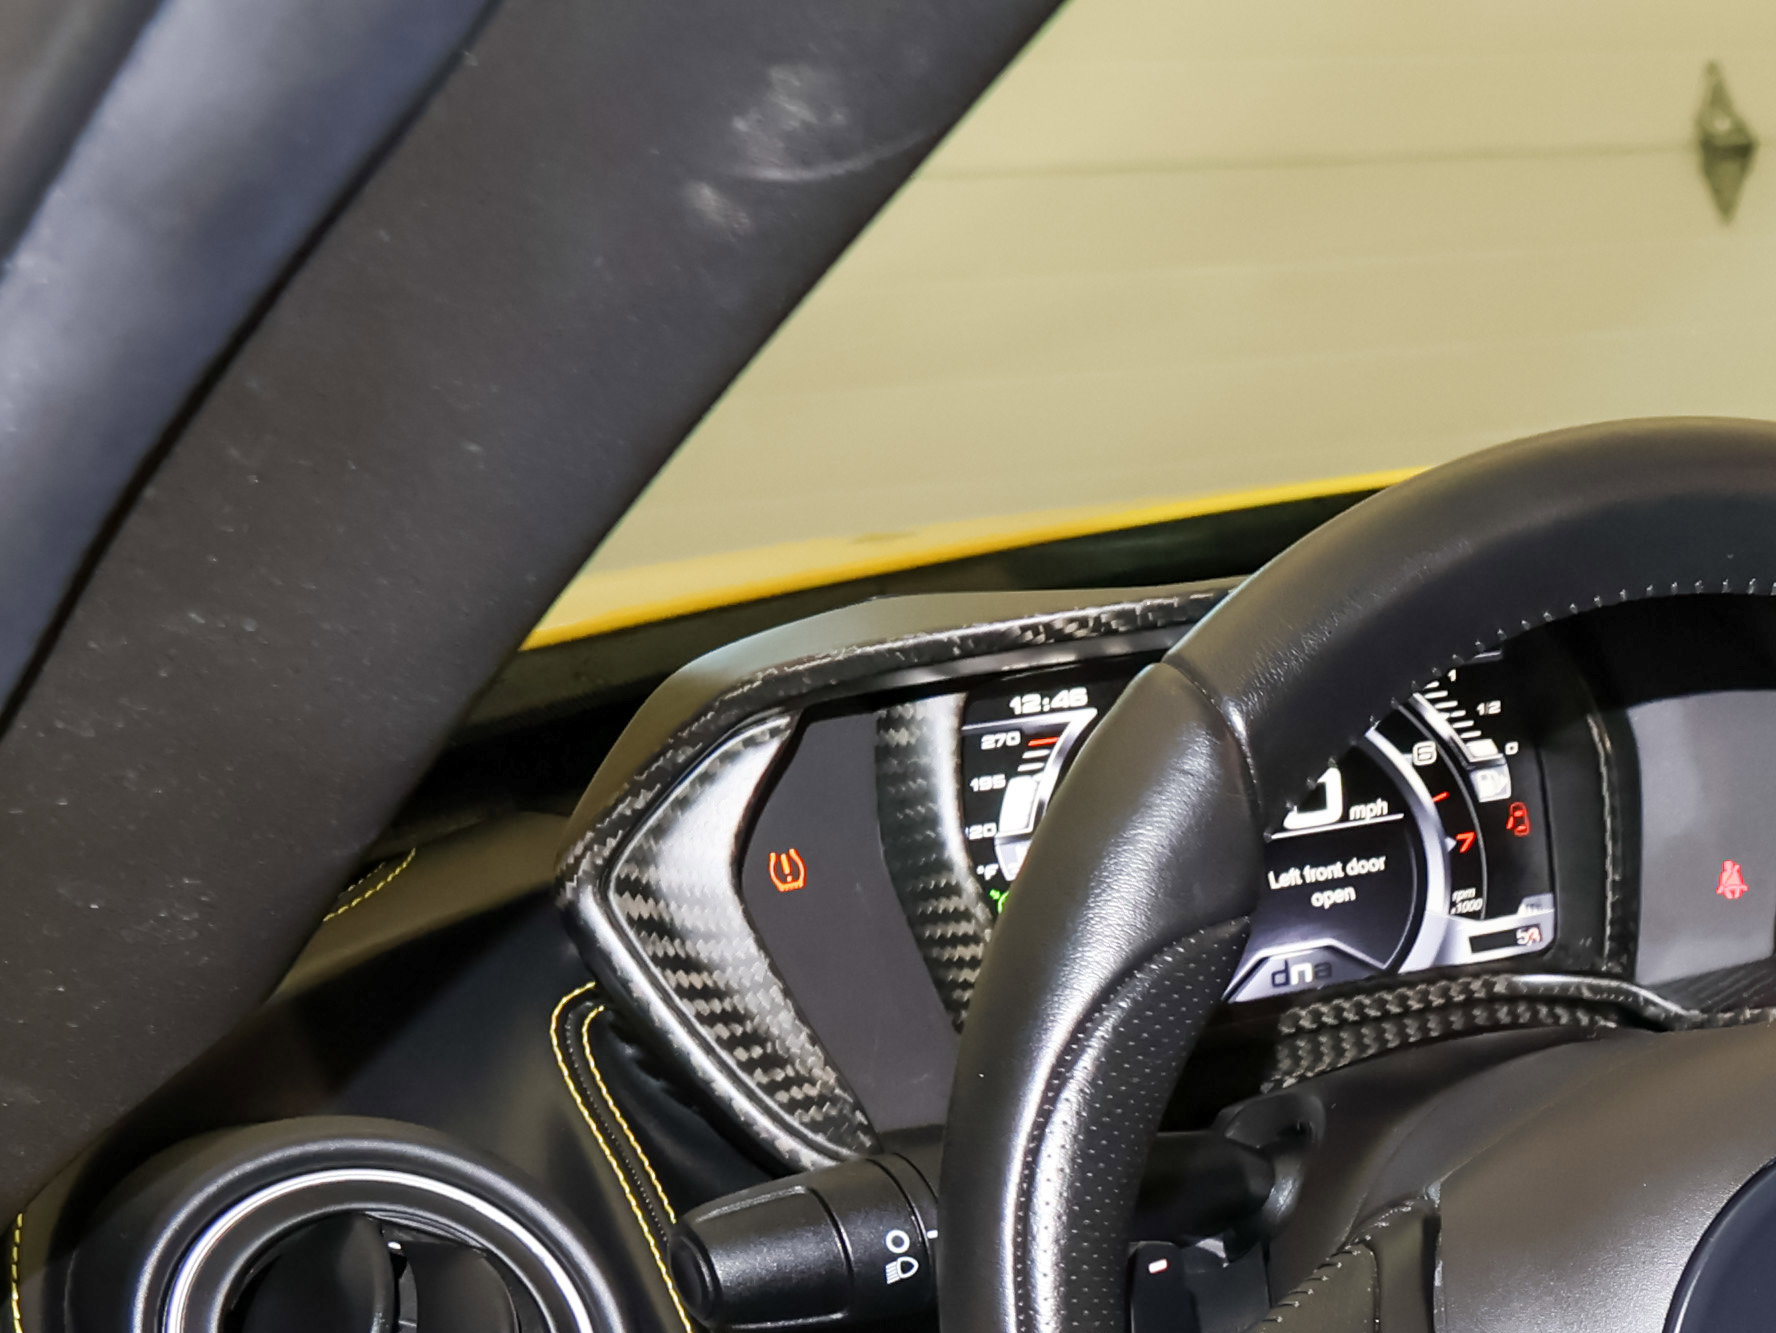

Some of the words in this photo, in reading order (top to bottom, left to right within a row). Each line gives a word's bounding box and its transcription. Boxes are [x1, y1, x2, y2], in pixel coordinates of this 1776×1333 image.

[1009, 687, 1089, 715] 12:46
[981, 731, 1021, 750] 270
[1412, 740, 1437, 766] 6
[1349, 798, 1388, 821] mph
[1455, 831, 1476, 853] 7
[1267, 867, 1302, 890] Left
[1302, 861, 1345, 884] front
[1345, 855, 1387, 877] door
[1310, 886, 1357, 909] open
[1271, 959, 1333, 988] dna
